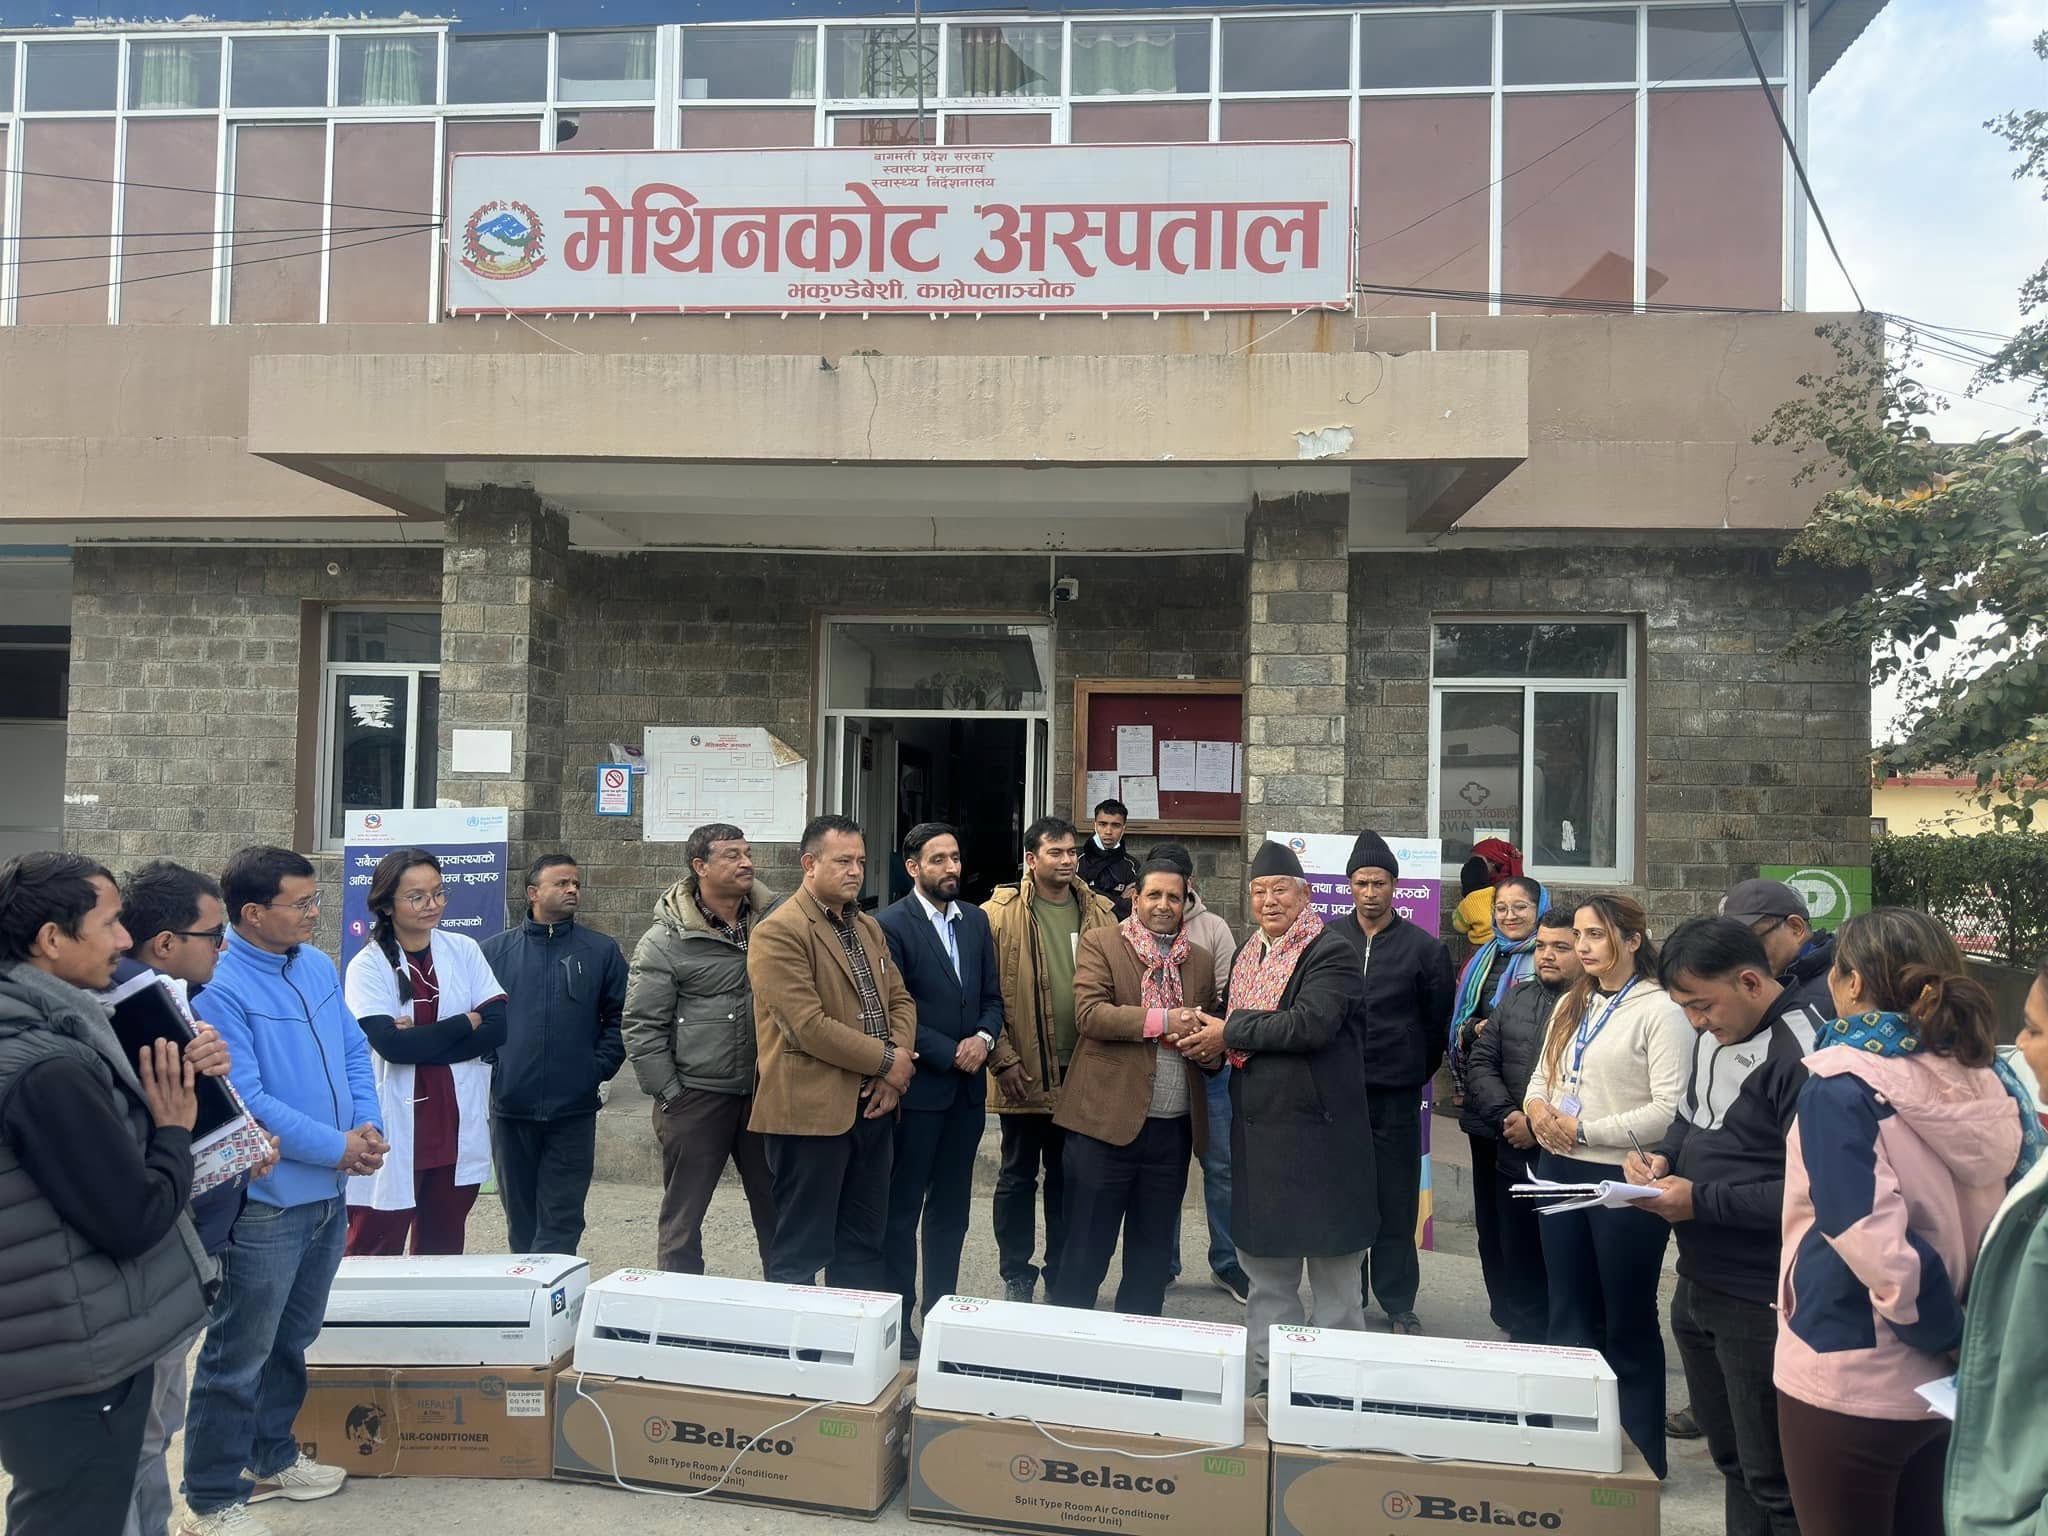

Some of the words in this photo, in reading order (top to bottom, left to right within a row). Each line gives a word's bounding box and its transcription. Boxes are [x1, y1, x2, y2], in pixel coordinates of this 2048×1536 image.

[874, 151, 915, 160] बागमती
[922, 151, 947, 161] प्रदेश
[954, 152, 994, 161] सरकार
[883, 165, 928, 174] स्वास्थ्य
[935, 165, 985, 174] मन्त्रालय
[872, 179, 918, 188] स्वास्थ्य
[926, 176, 996, 188] निर्देशनालय
[564, 182, 948, 274] मेथिनकोट
[974, 201, 1328, 278] अस्पताल
[917, 279, 1076, 300] काभ्रेपलाञ्चोक
[400, 1433, 488, 1442] AIR-CONDITIONER
[671, 1421, 793, 1455] Belaco
[648, 1456, 668, 1465] Split
[670, 1458, 691, 1469] Type
[693, 1461, 718, 1471] Room
[720, 1465, 733, 1473] Ai
[735, 1467, 788, 1480] Conditioner
[689, 1472, 721, 1482] (Indoor
[1040, 1459, 1175, 1495] Belaco
[1015, 1496, 1038, 1506] Split
[1040, 1499, 1062, 1509] Type
[1064, 1502, 1093, 1512] Room
[1095, 1506, 1109, 1514] Air
[1111, 1507, 1170, 1521] Conditioner
[1061, 1511, 1097, 1523] (Indoor
[1098, 1515, 1122, 1527] Unit)
[1414, 1495, 1562, 1530] Belaco
